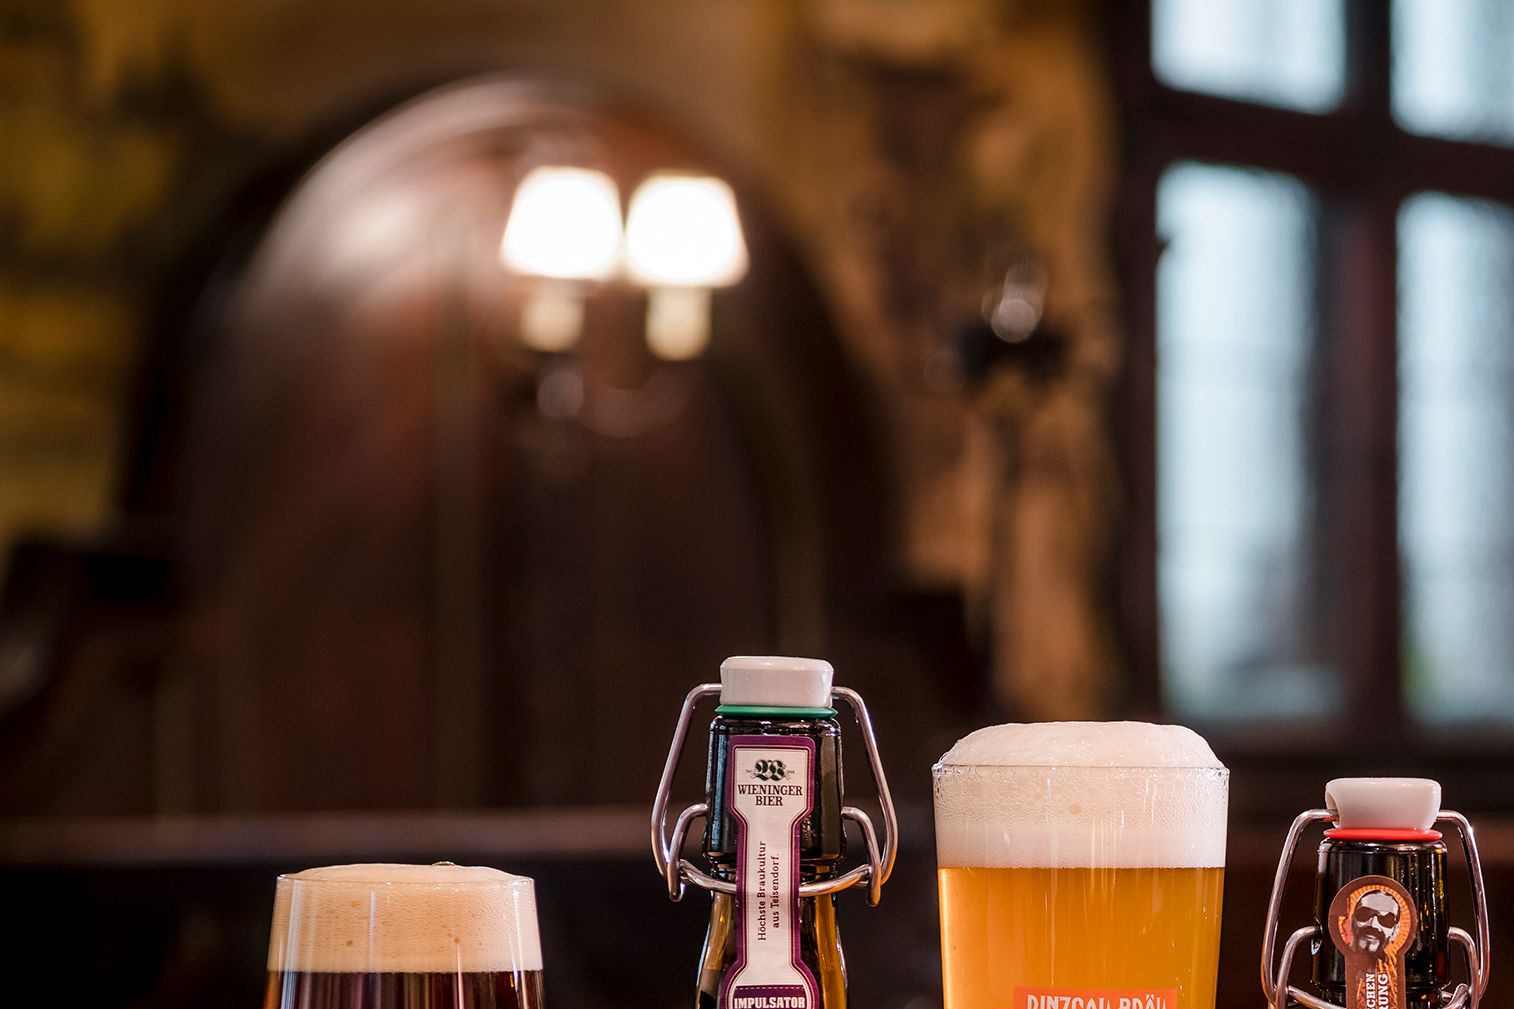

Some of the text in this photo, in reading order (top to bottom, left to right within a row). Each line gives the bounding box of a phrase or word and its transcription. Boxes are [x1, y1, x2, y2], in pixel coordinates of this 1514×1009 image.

[738, 785, 802, 796] WIENINGER
[756, 796, 783, 806] BIER
[756, 841, 766, 898] Braukultur
[757, 901, 766, 940] Höchste
[734, 997, 806, 1009] IMPULSATOR
